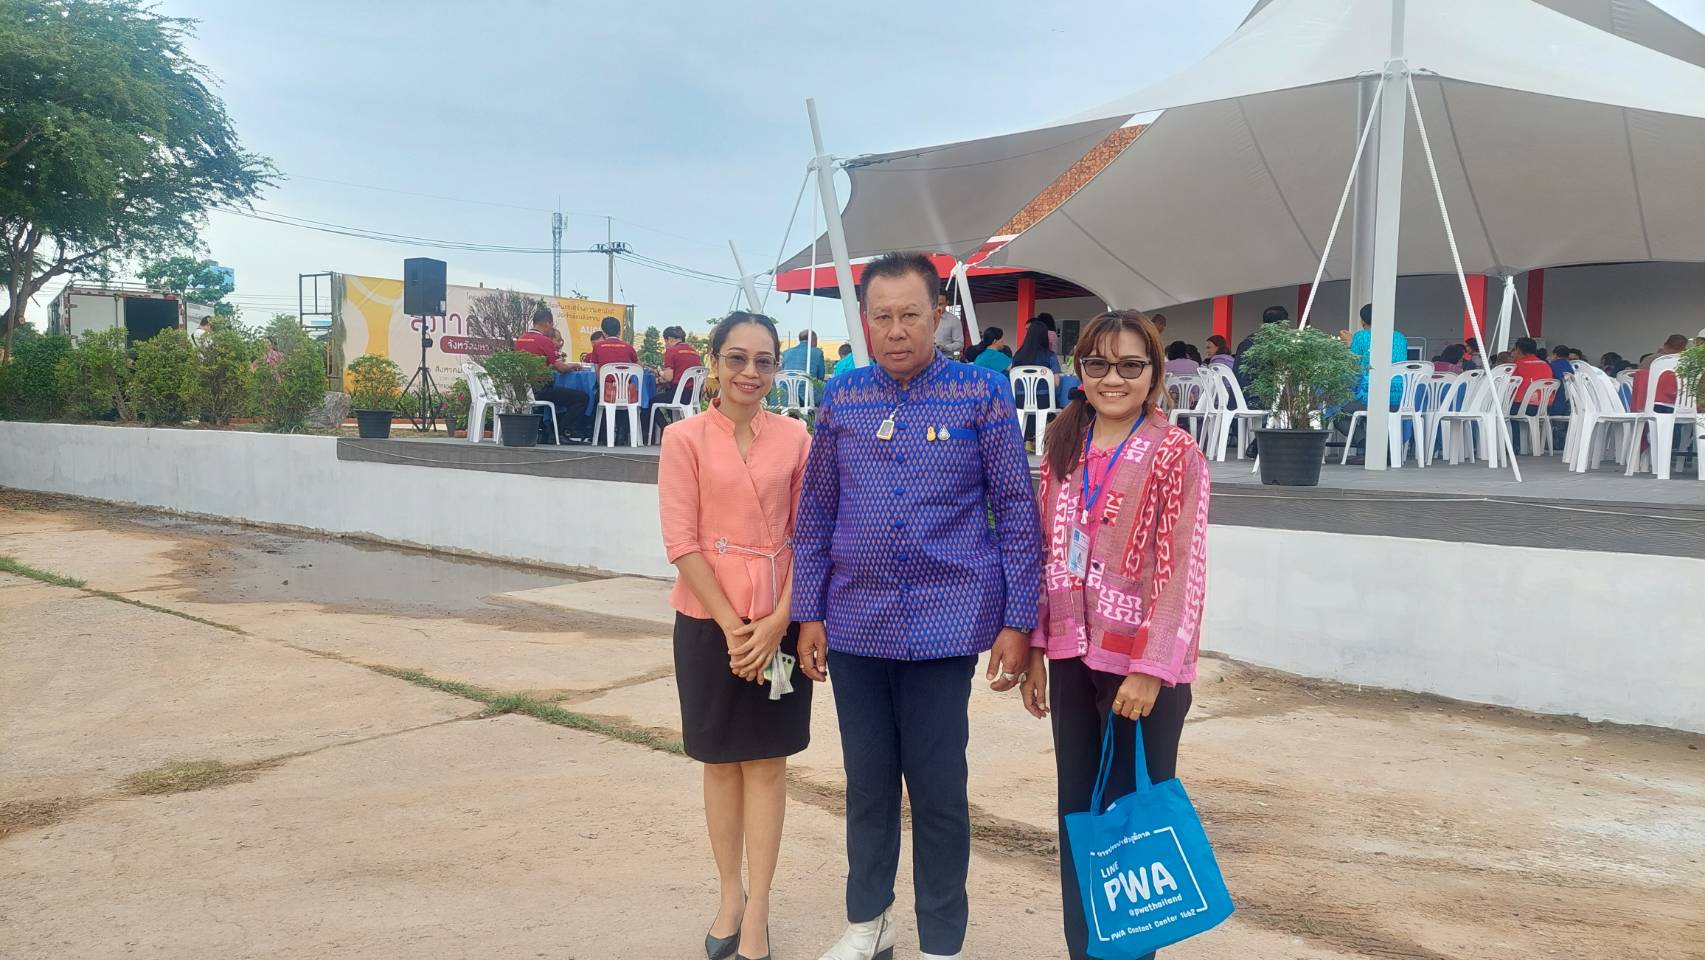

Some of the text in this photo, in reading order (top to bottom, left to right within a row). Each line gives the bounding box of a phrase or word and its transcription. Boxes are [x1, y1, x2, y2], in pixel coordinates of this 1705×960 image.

[1100, 860, 1119, 879] LINE
[1104, 862, 1178, 912] PWA
[1111, 929, 1126, 941] PWA
[1127, 923, 1153, 935] Contact
[1154, 914, 1178, 929] Center
